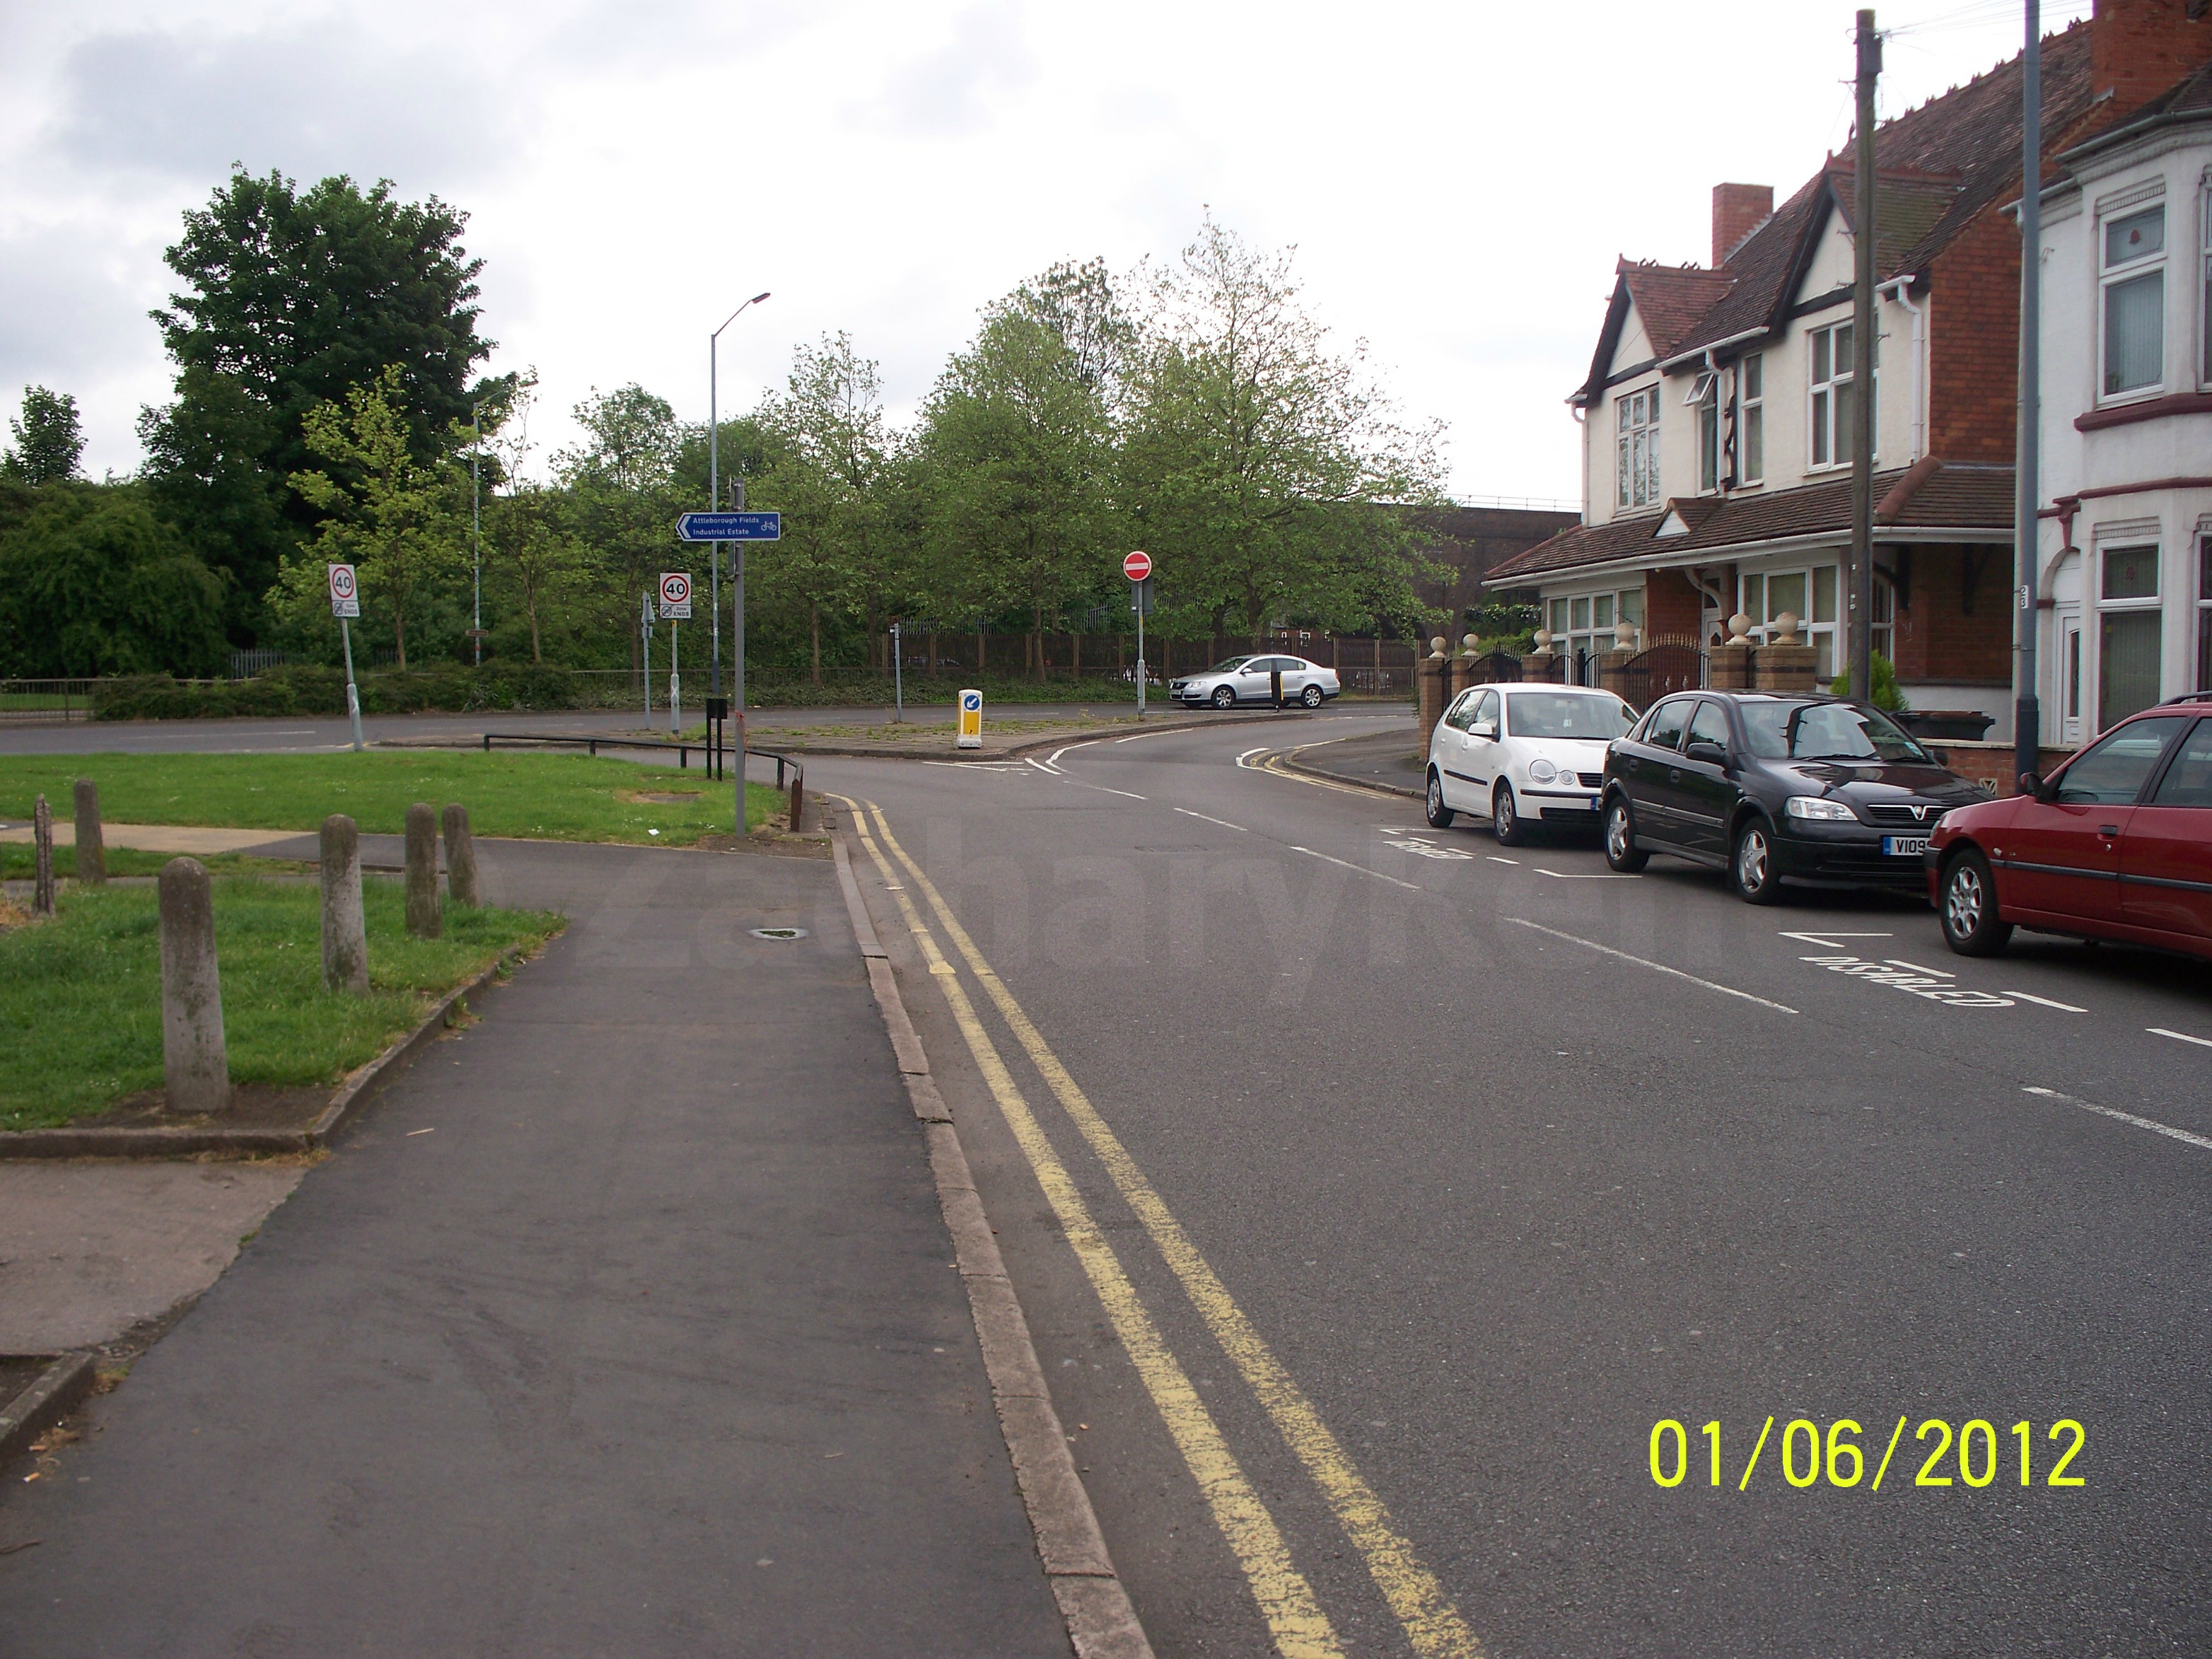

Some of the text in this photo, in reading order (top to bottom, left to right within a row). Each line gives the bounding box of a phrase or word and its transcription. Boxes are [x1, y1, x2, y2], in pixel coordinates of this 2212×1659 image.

[335, 576, 351, 589] 40
[665, 583, 685, 594] 40
[1798, 956, 2015, 1007] DISABLED
